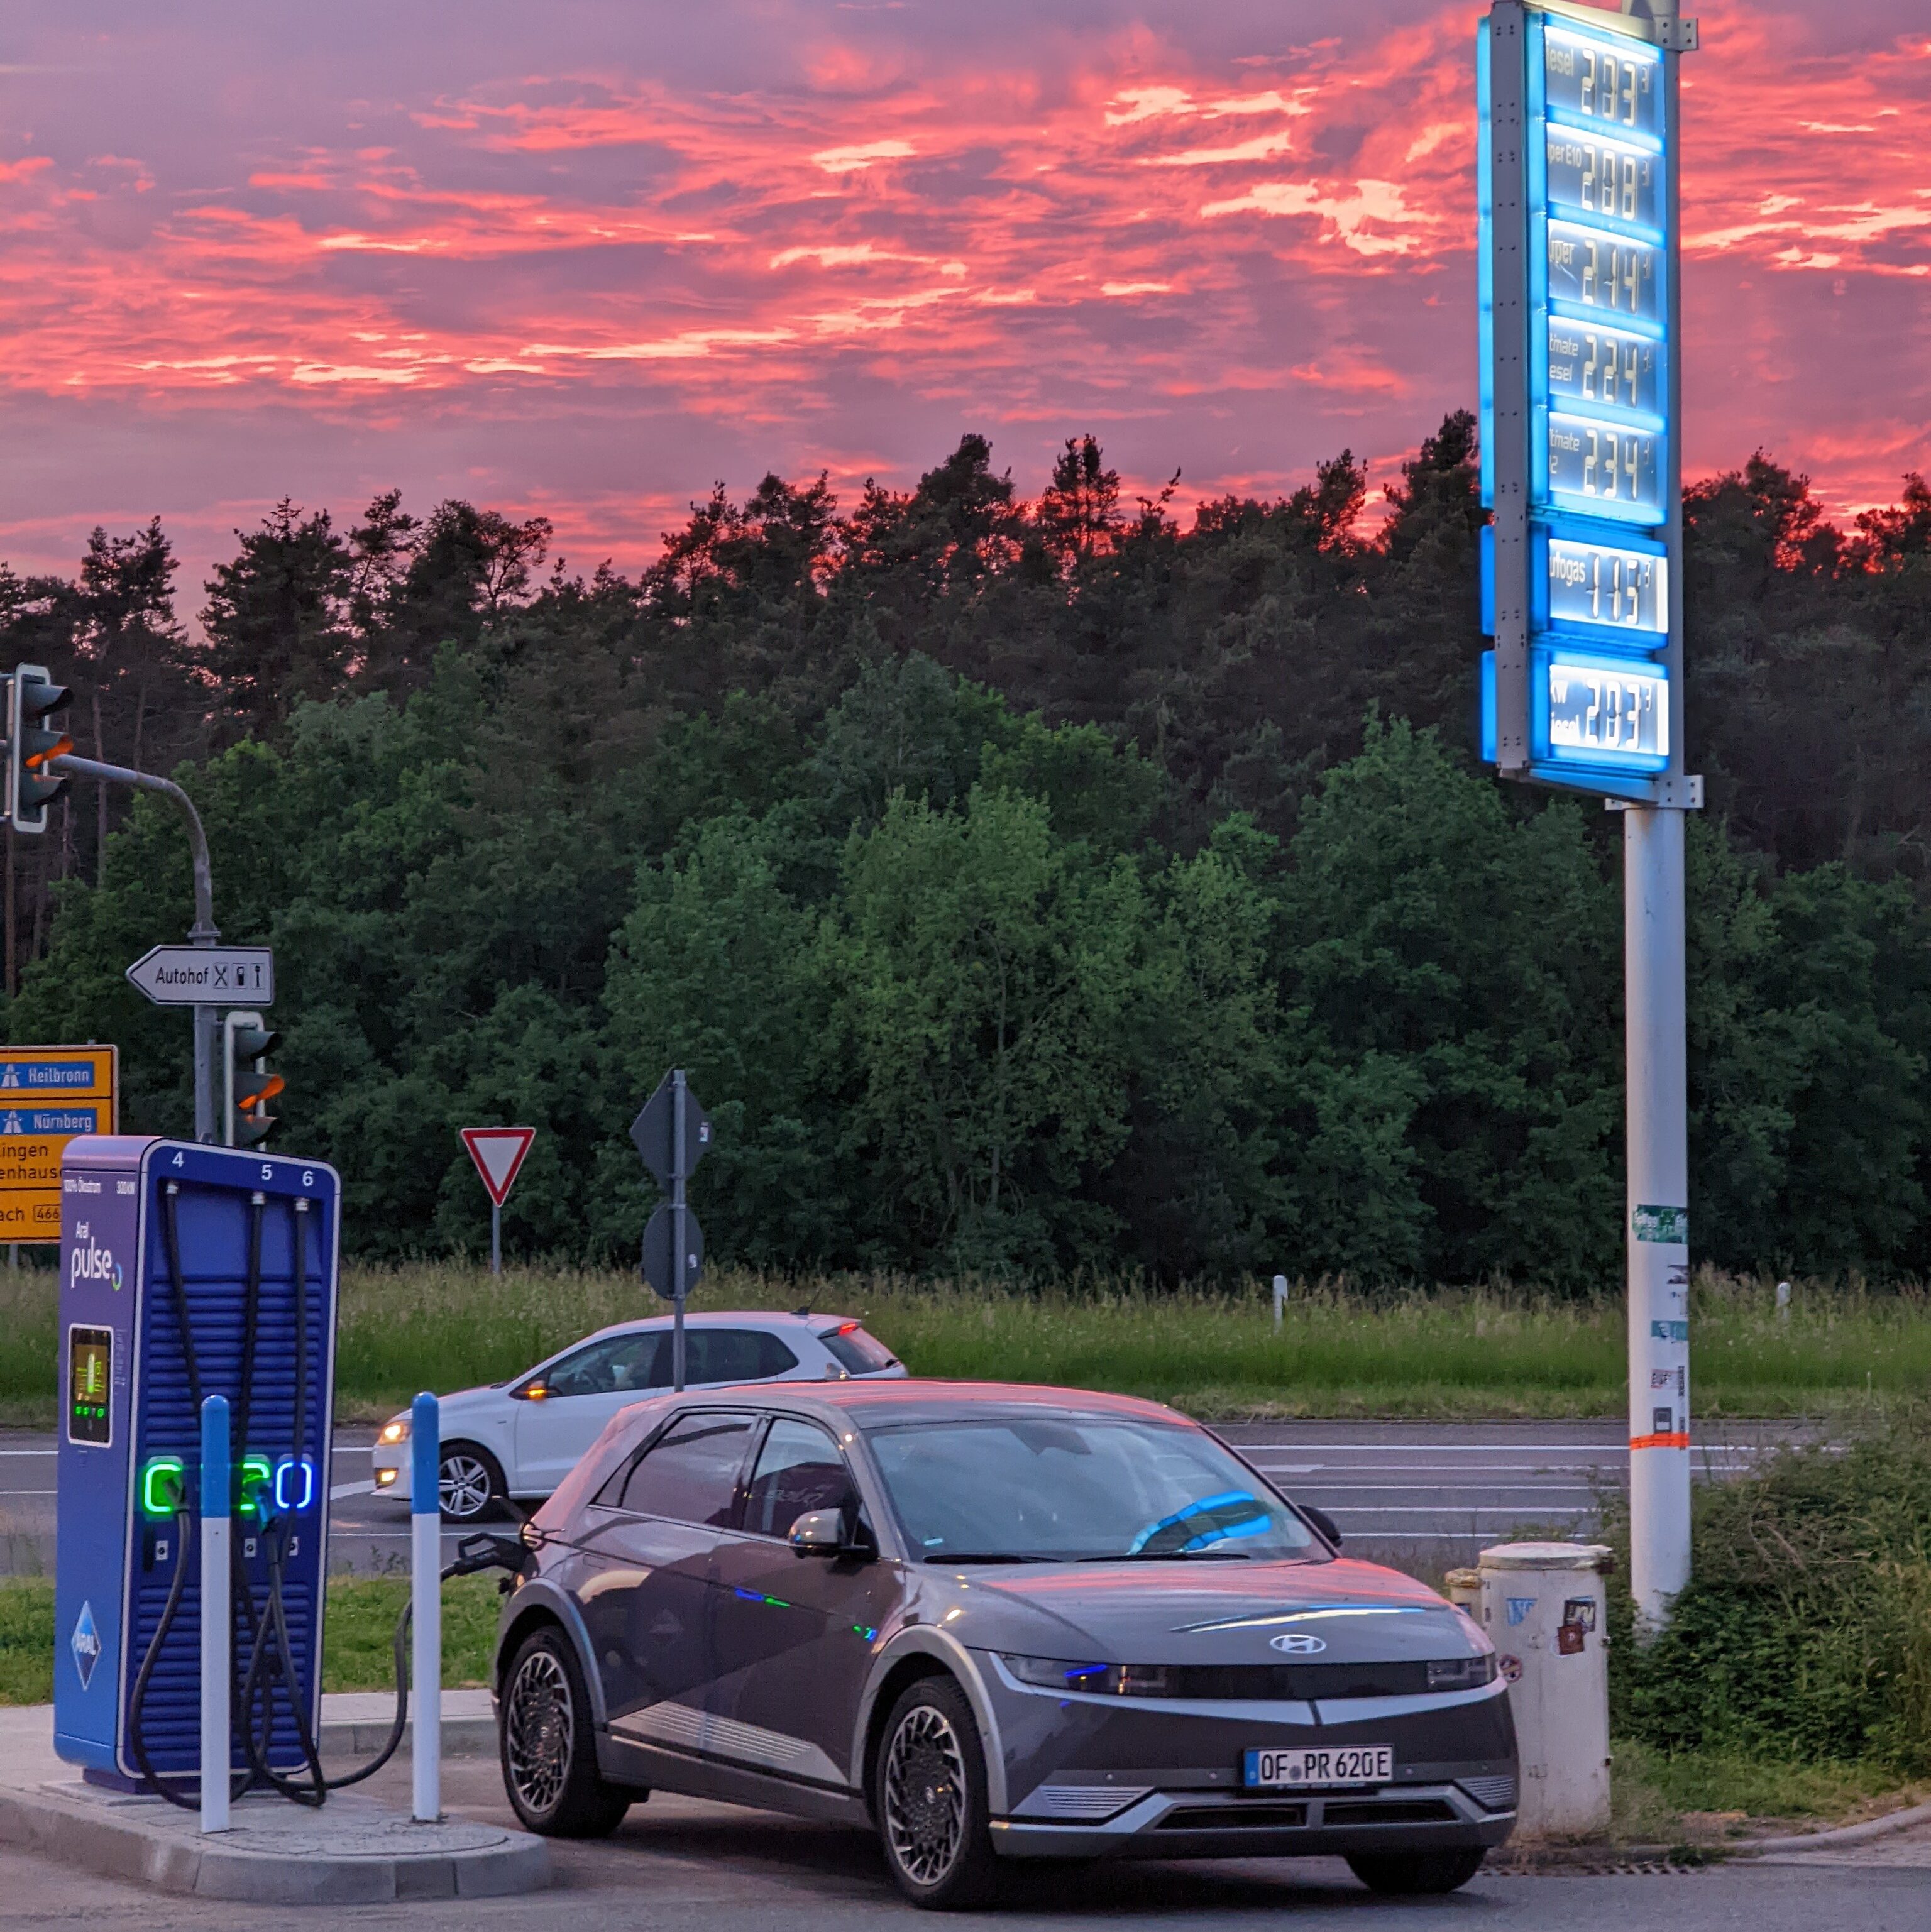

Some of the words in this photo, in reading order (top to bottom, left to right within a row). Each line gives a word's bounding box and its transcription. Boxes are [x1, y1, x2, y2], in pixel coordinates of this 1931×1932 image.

[1566, 144, 1582, 168] E10
[1582, 143, 1637, 221] 208
[1583, 334, 1639, 407] 224
[1583, 427, 1639, 499] 234
[155, 967, 209, 984] Autohof
[28, 1068, 89, 1083] Heilbronn
[34, 1112, 92, 1131] Nürnberg
[172, 1151, 184, 1168] 4
[261, 1164, 273, 1181] 5
[302, 1170, 314, 1187] 6
[71, 1236, 113, 1288] pulse
[1261, 1754, 1288, 1781] OF
[1304, 1753, 1331, 1779] PR
